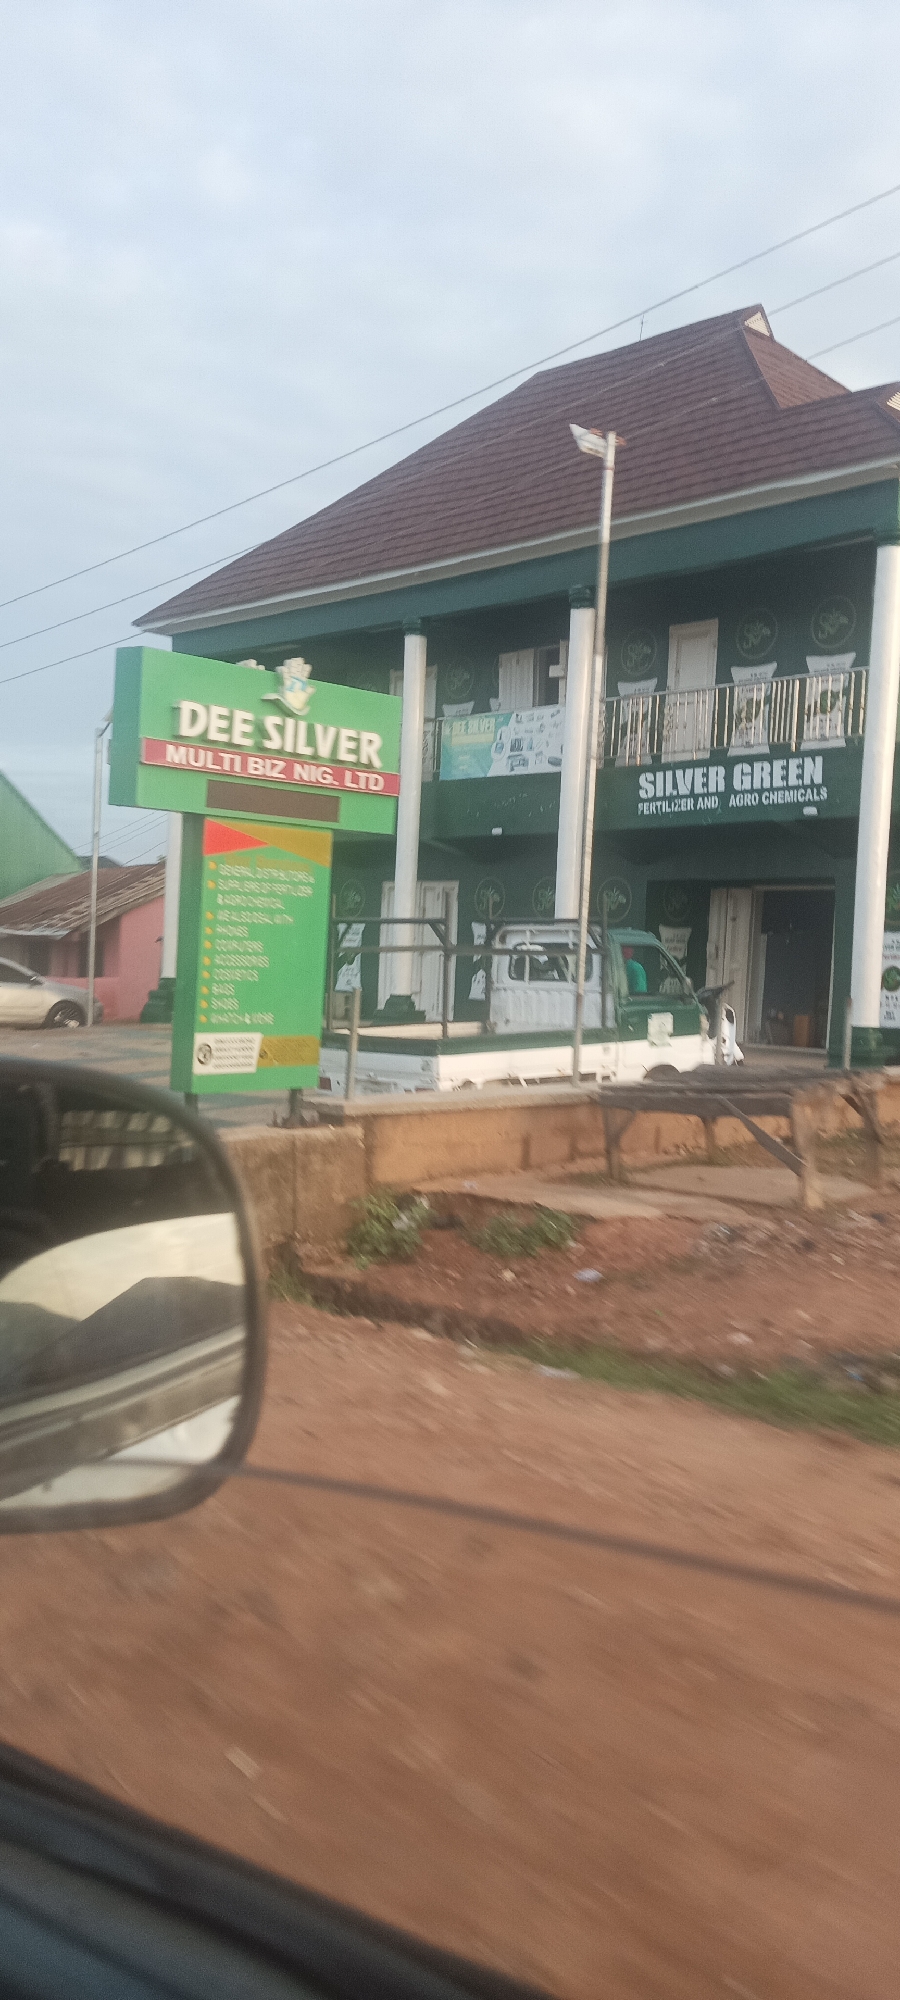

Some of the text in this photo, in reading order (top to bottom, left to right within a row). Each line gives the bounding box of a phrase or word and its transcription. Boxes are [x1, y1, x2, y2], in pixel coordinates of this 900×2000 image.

[178, 699, 383, 769] DEE SILVER
[165, 743, 385, 791] MULTI BIZ NIG. LTD
[638, 755, 824, 799] SILVER GREEN
[697, 795, 719, 810] AND
[728, 792, 760, 808] AGRO
[762, 785, 828, 806] CHEMICALS
